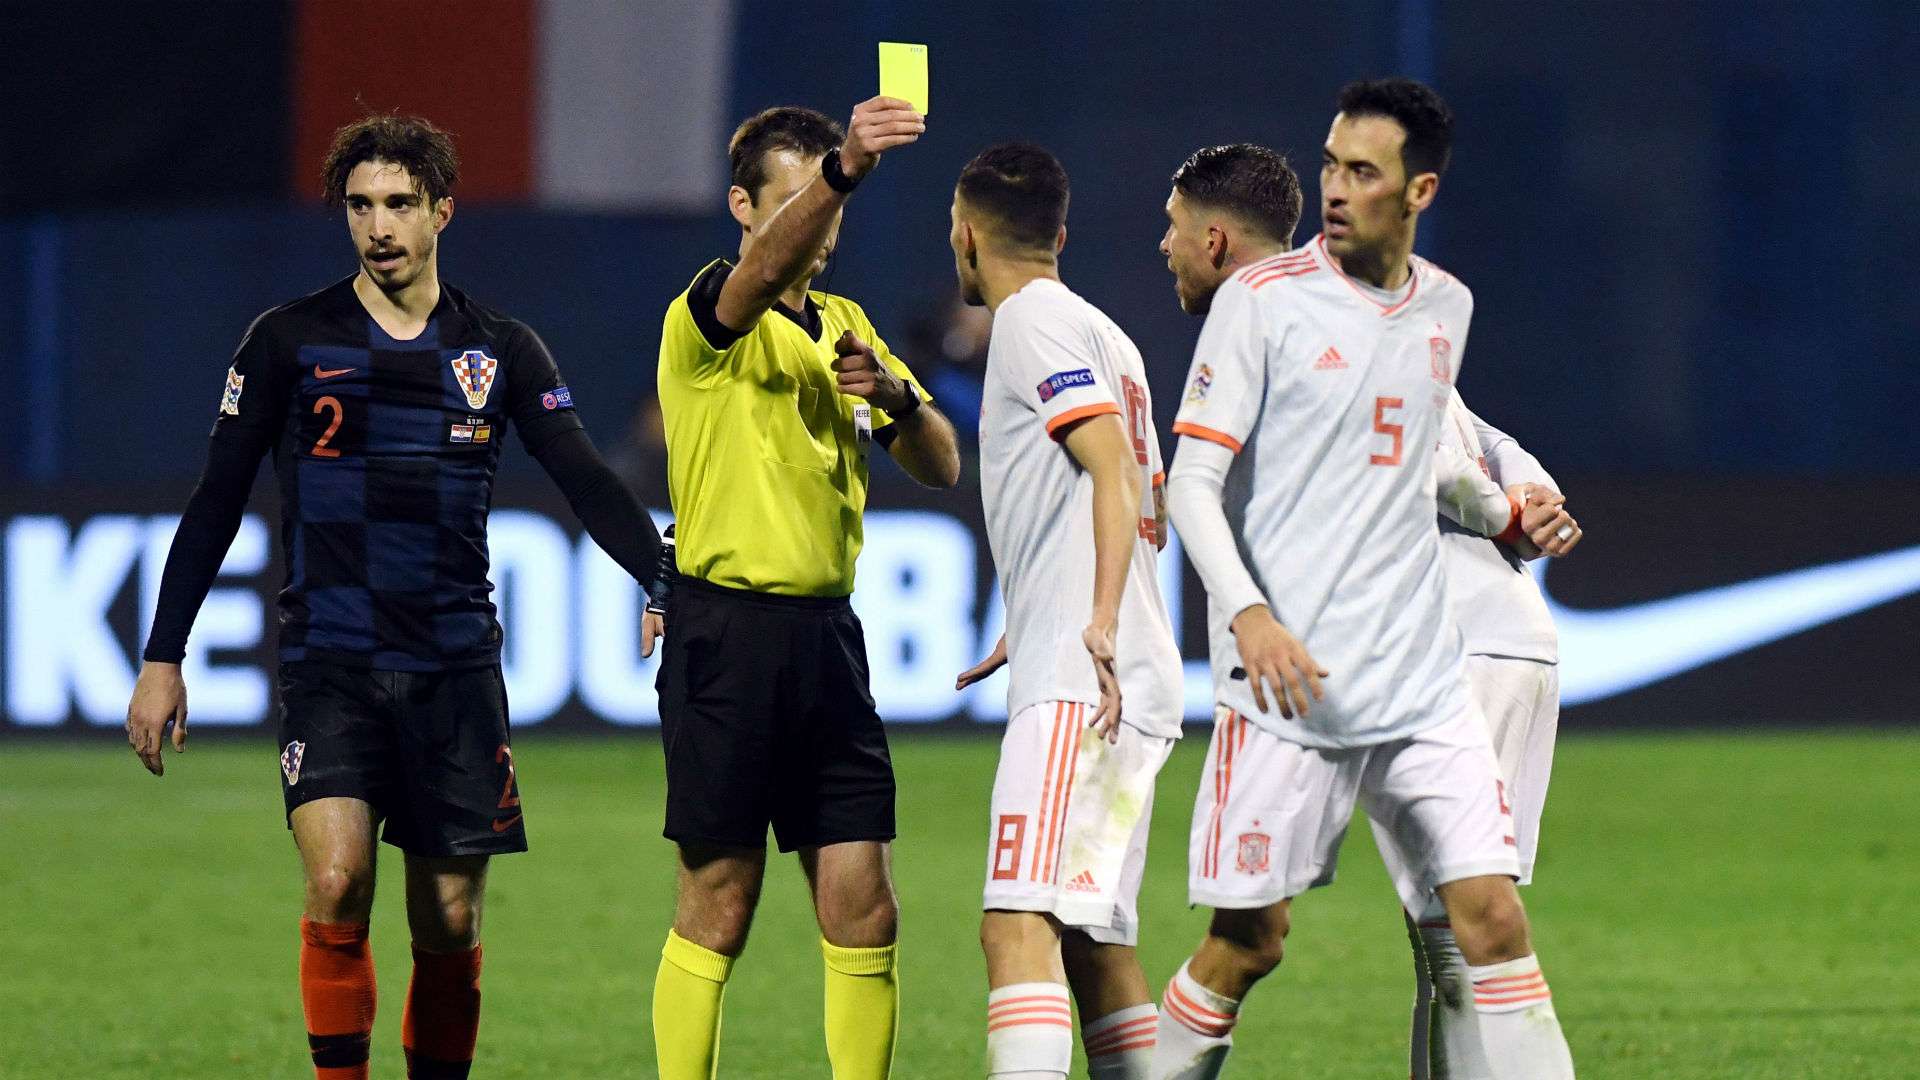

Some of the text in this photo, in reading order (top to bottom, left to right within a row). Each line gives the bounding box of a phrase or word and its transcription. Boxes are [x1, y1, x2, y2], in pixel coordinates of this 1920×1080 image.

[1051, 372, 1092, 389] RESPECT
[313, 396, 343, 458] 2
[1370, 397, 1403, 465] 5
[496, 744, 520, 809] 2
[993, 815, 1027, 881] 8
